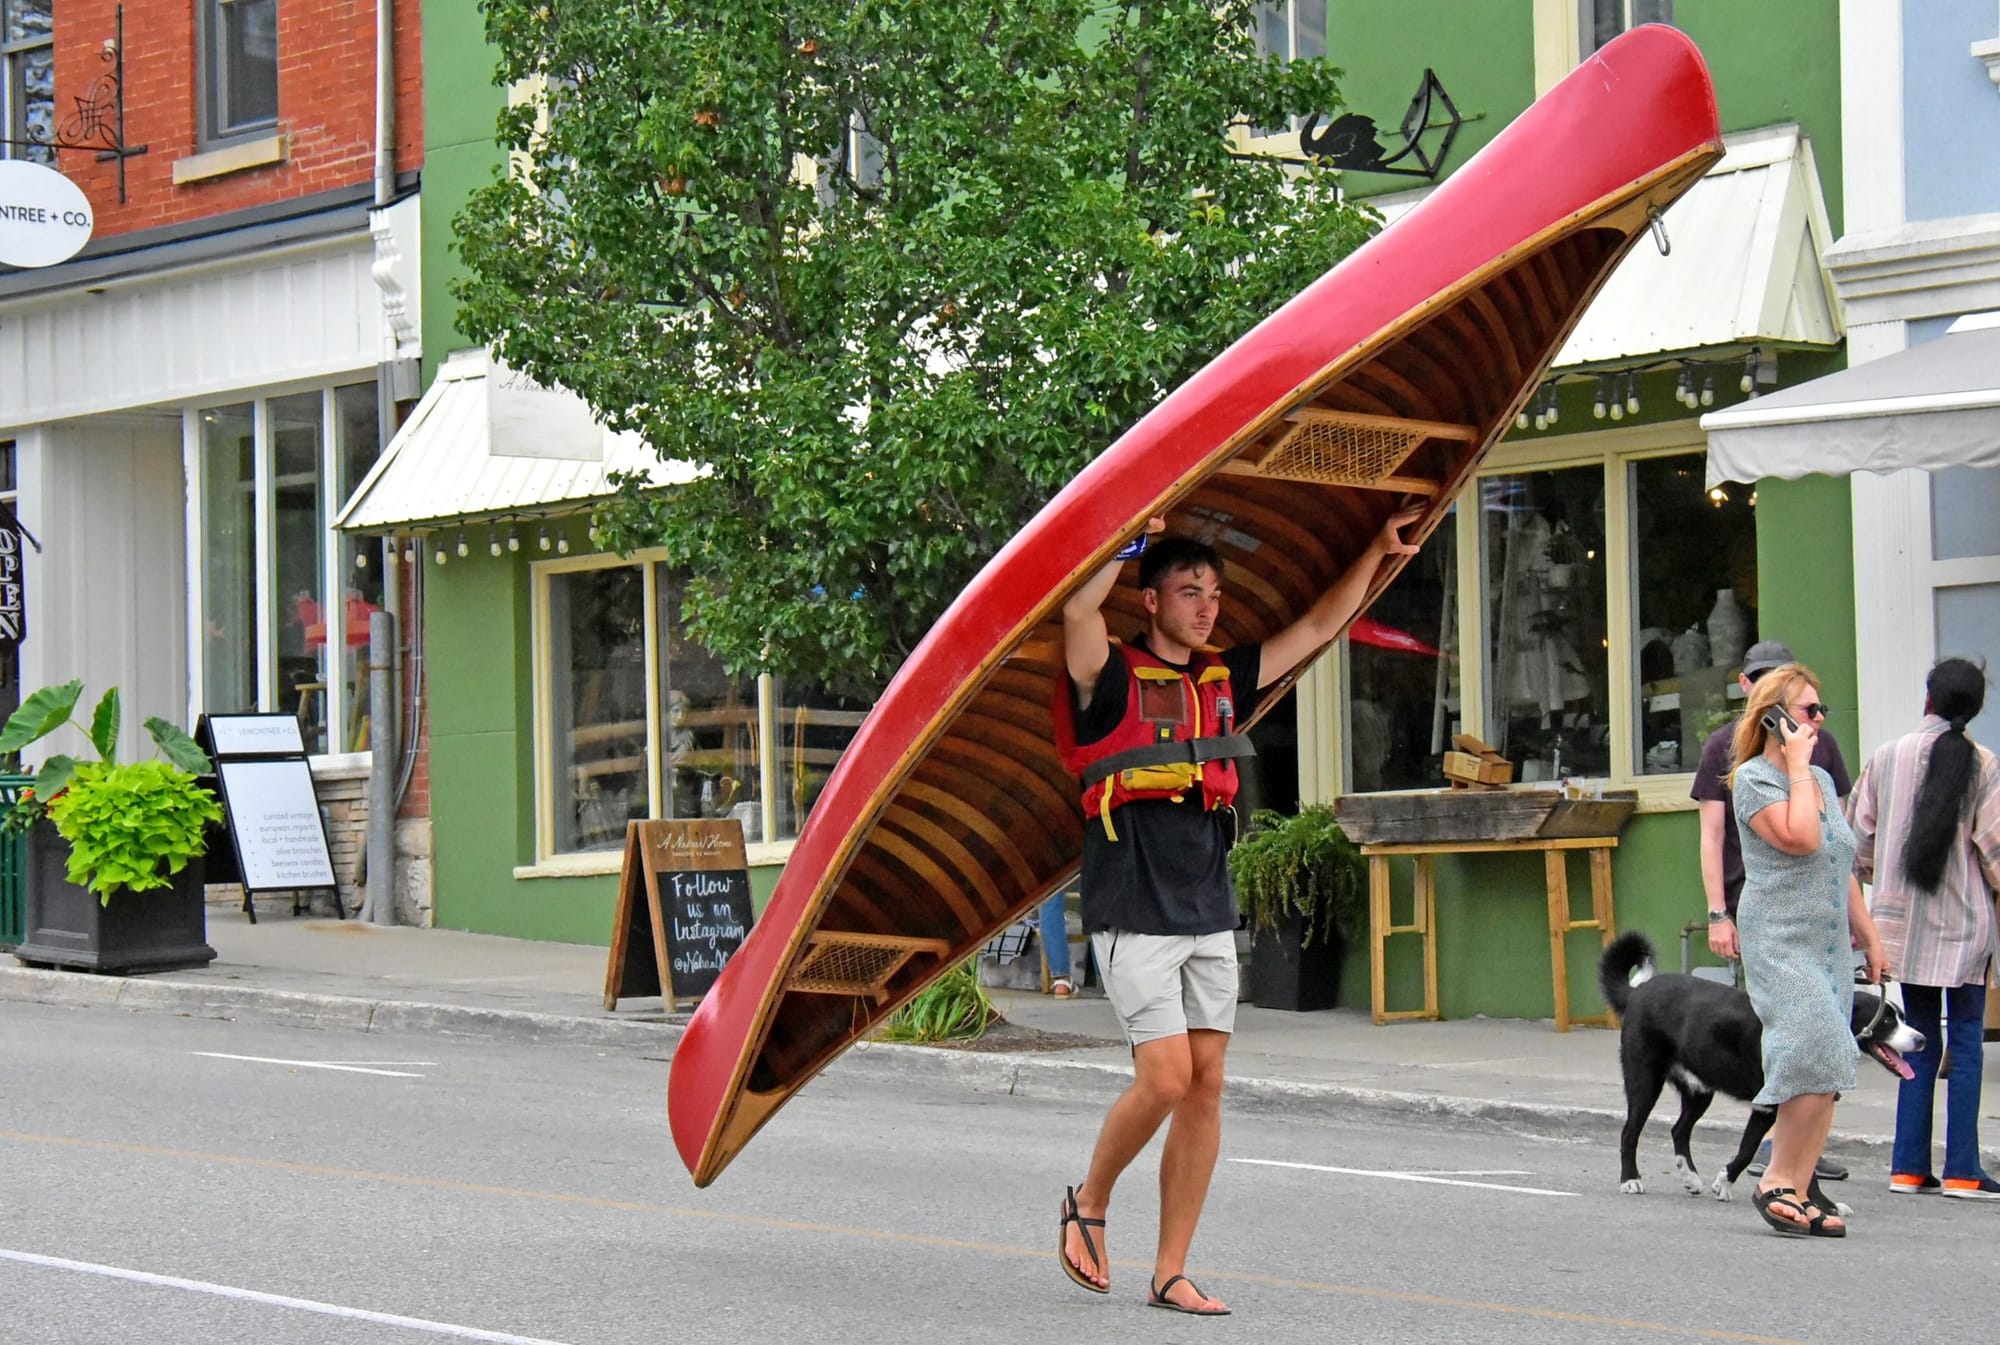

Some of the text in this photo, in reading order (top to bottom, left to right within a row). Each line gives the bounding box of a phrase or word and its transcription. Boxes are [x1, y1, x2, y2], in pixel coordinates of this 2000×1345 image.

[63, 210, 91, 227] CO.
[657, 832, 672, 849] A
[671, 832, 708, 849] Natural
[671, 873, 734, 897] Follow
[687, 903, 739, 924] us on
[674, 917, 745, 950] Instagram
